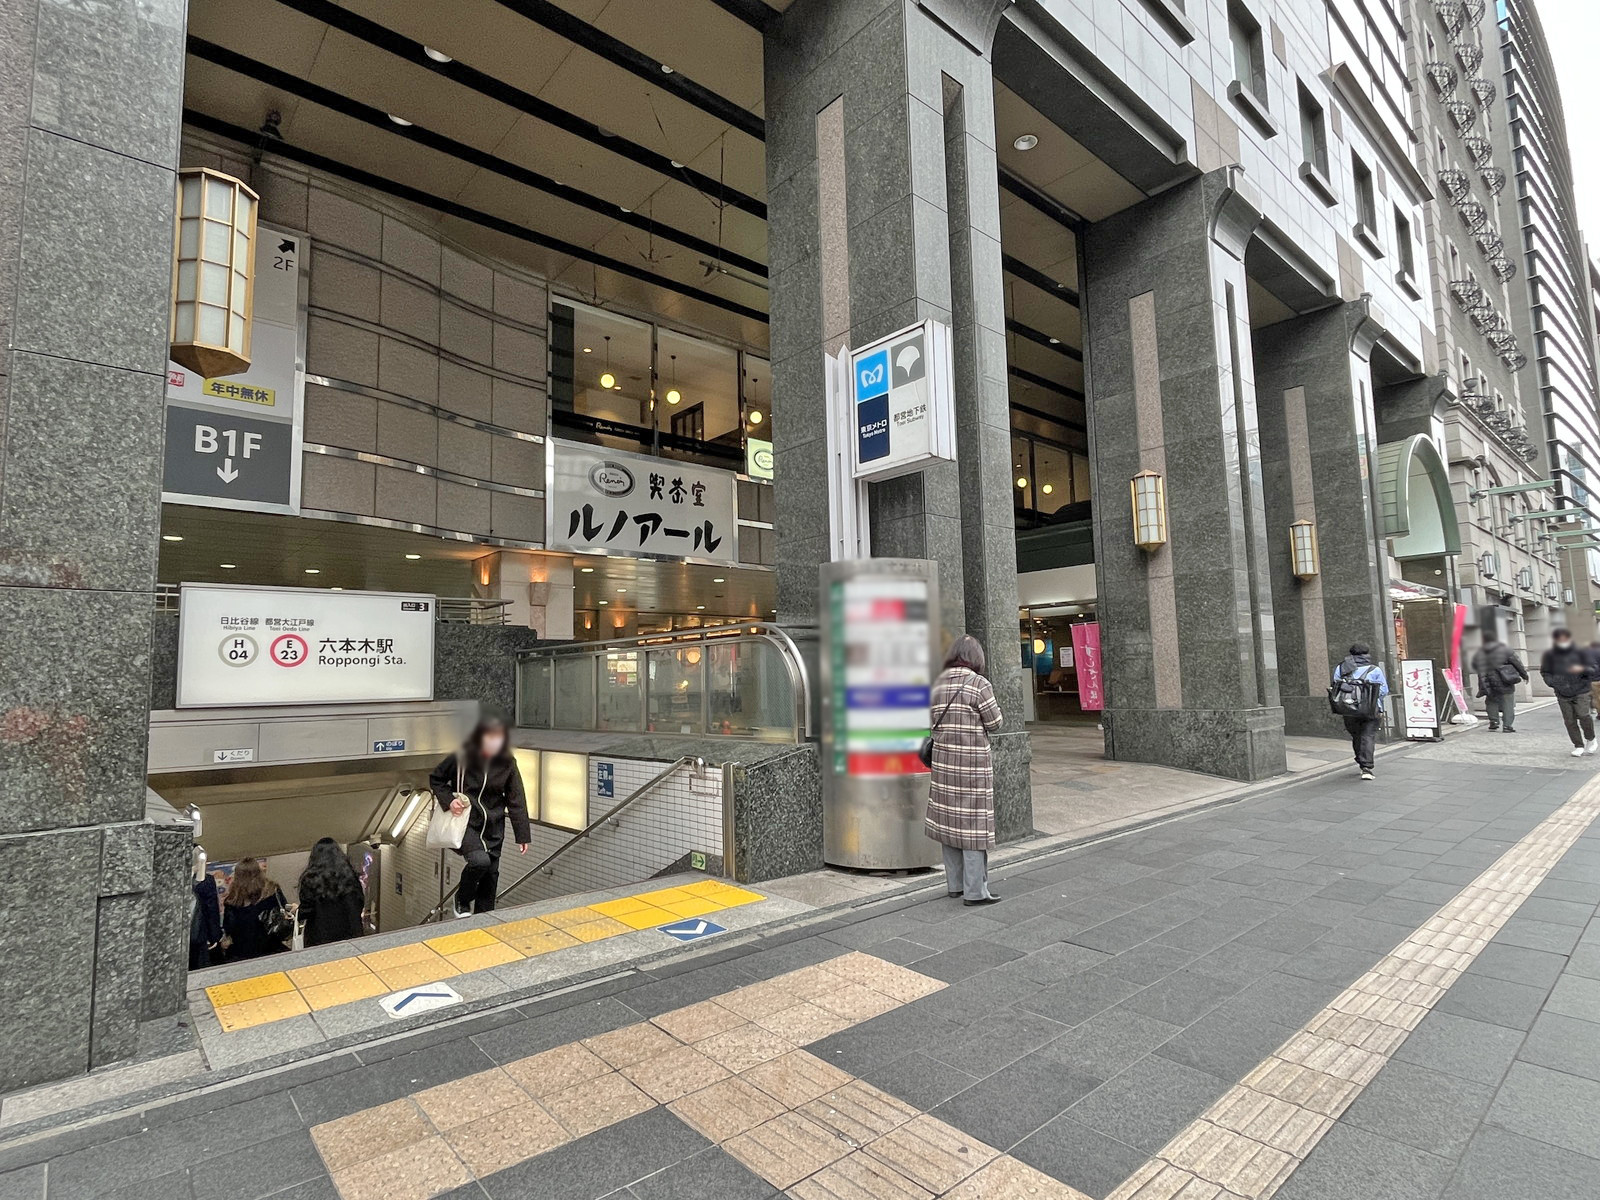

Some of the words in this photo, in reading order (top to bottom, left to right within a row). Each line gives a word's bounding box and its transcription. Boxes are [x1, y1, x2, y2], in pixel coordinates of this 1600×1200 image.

[273, 256, 294, 272] 2F
[211, 382, 269, 402] 年中無休
[893, 404, 927, 422] 都営地下鉄
[860, 419, 887, 434] 東京メトロ
[194, 424, 262, 459] B1F
[649, 472, 706, 507] 喫茶室
[568, 503, 722, 553] ルノアール
[419, 602, 425, 611] 3
[220, 616, 259, 626] 日比谷線
[265, 617, 315, 627] 都営大江戸線
[234, 639, 244, 649] H
[286, 640, 293, 649] E
[319, 637, 394, 655] 六本木駅
[229, 650, 248, 660] 04
[280, 650, 298, 660] 23
[318, 655, 381, 668] Roppongi
[384, 655, 407, 666] Sta.
